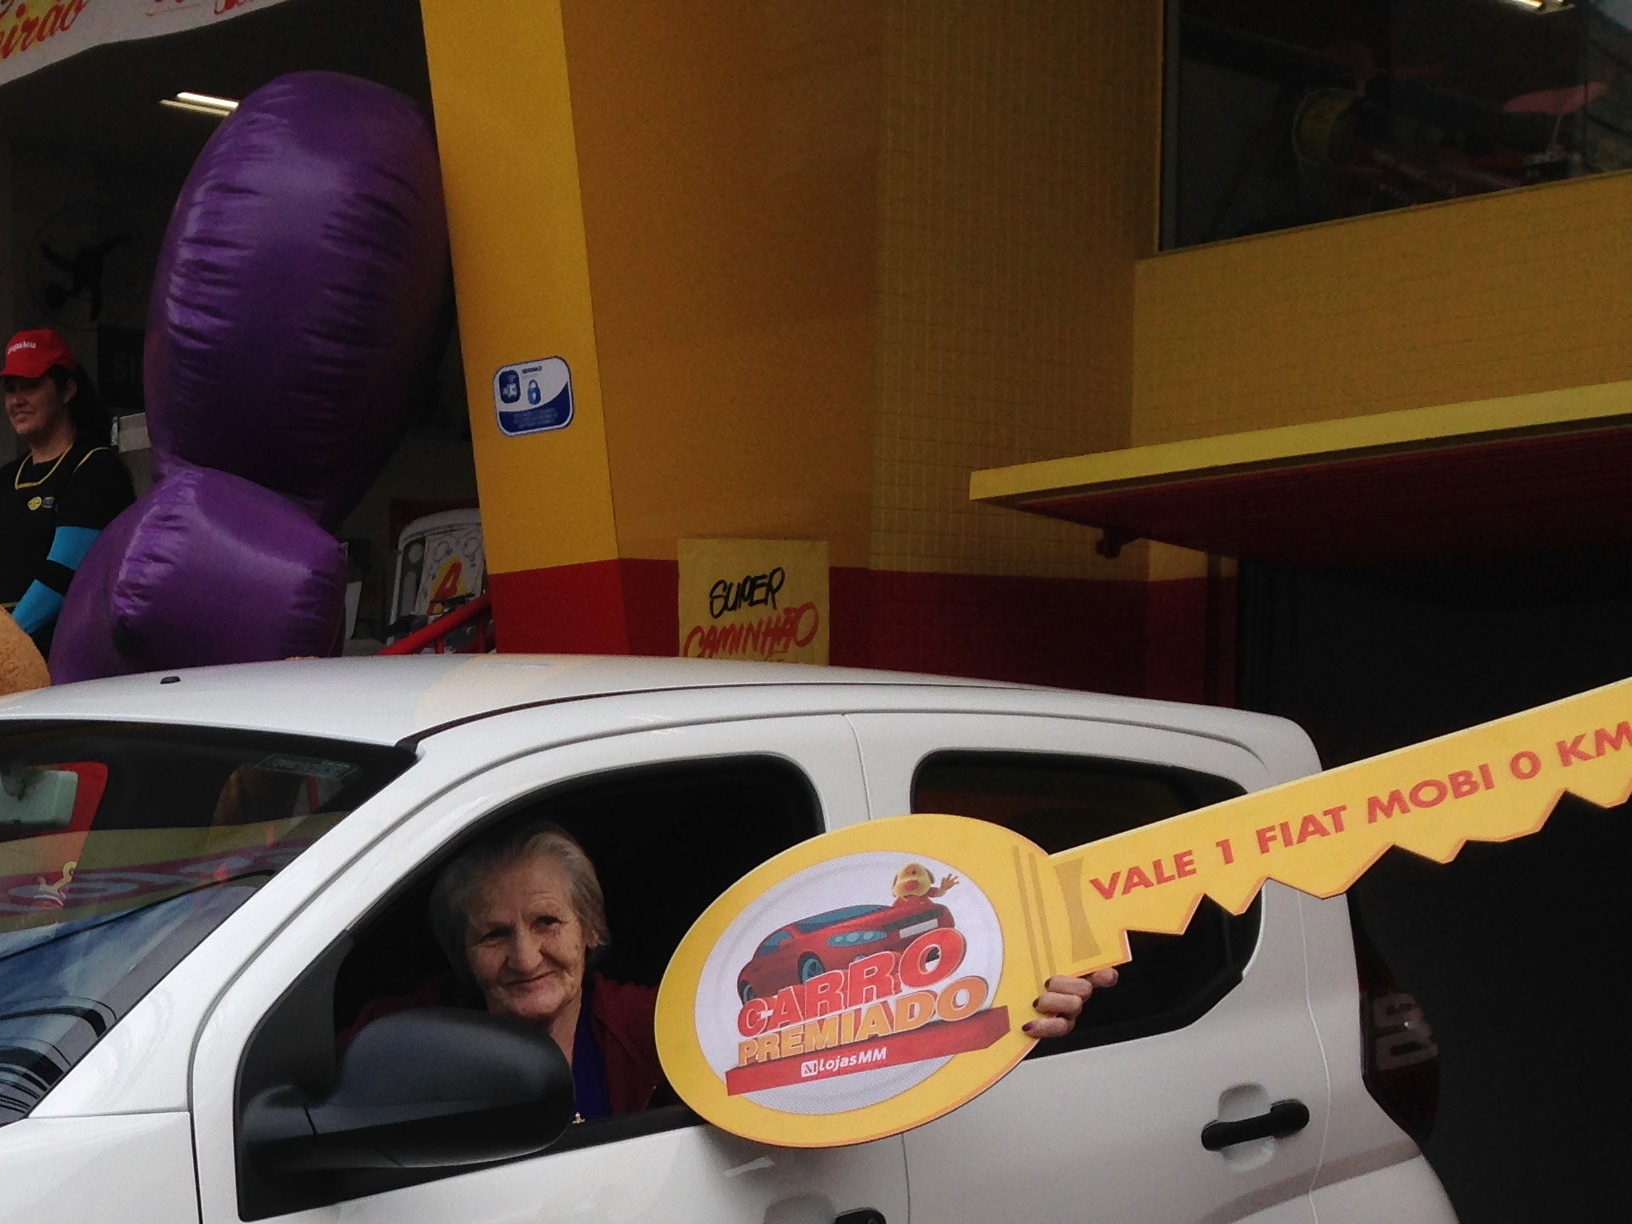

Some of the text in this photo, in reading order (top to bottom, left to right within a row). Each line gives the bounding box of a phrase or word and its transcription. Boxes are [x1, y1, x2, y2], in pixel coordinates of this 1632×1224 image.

[683, 601, 820, 658] CAMINHÃO
[709, 567, 786, 619] SUPER
[1090, 849, 1197, 900] VALE
[1215, 838, 1235, 866] 1
[1256, 804, 1348, 855] FIAT
[1367, 762, 1495, 823] MOBI
[1555, 720, 1632, 767] KM
[737, 927, 968, 1037] CARRO
[737, 976, 989, 1068] PREMIADO
[818, 1047, 888, 1074] LojasMM
